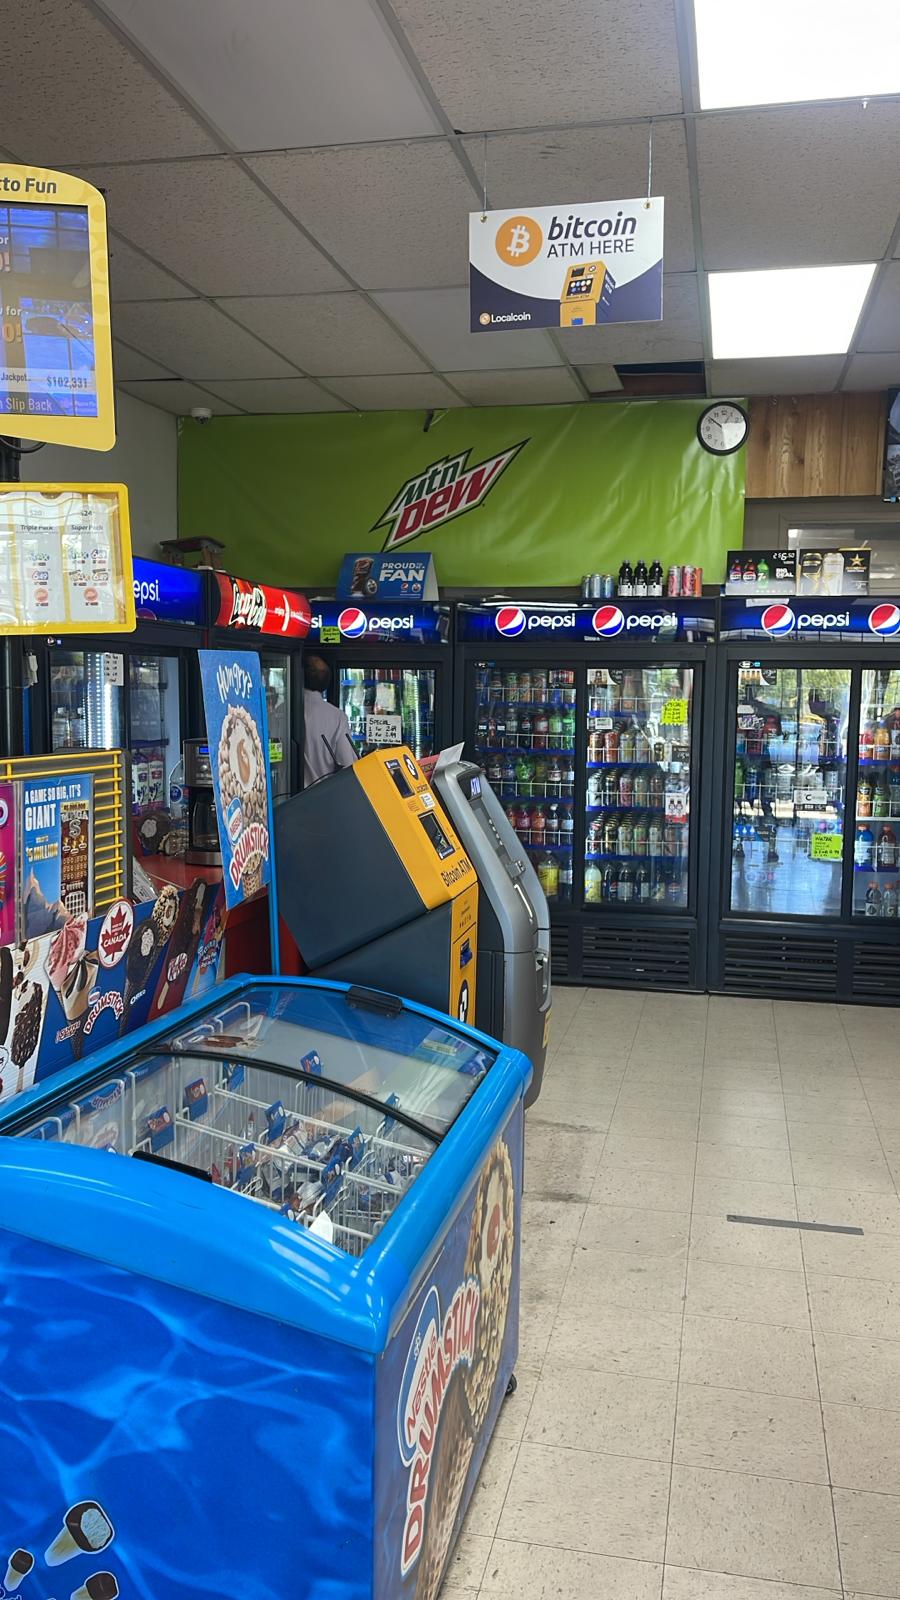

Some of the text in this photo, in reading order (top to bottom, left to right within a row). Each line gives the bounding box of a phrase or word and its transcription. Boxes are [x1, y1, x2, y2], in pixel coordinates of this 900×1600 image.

[0, 177, 57, 194] to Fun
[548, 211, 637, 241] bitcoin
[547, 238, 635, 259] ATM HERE
[491, 311, 531, 323] Localcoin
[46, 376, 88, 389] $102,331
[6, 397, 53, 412] Slip Back
[392, 460, 460, 514] Mtn
[379, 569, 425, 582] FAN
[133, 579, 160, 605] epsi
[368, 615, 414, 631] pepsi
[528, 613, 576, 630] pepsi
[626, 612, 676, 630] pepsi
[797, 611, 850, 629] pepsi
[216, 662, 253, 704] Hungry?
[25, 791, 30, 805] A
[30, 788, 47, 804] GAME
[48, 787, 56, 802] SO
[69, 783, 81, 799] IT'S
[25, 803, 57, 832] GIANT
[230, 825, 268, 887] DRUMSTICK
[441, 857, 472, 887] Bitcoin ATM
[103, 933, 127, 948] CANADA
[83, 991, 124, 1034] DRUMSTICK
[402, 1284, 479, 1563] DRUMSTICK
